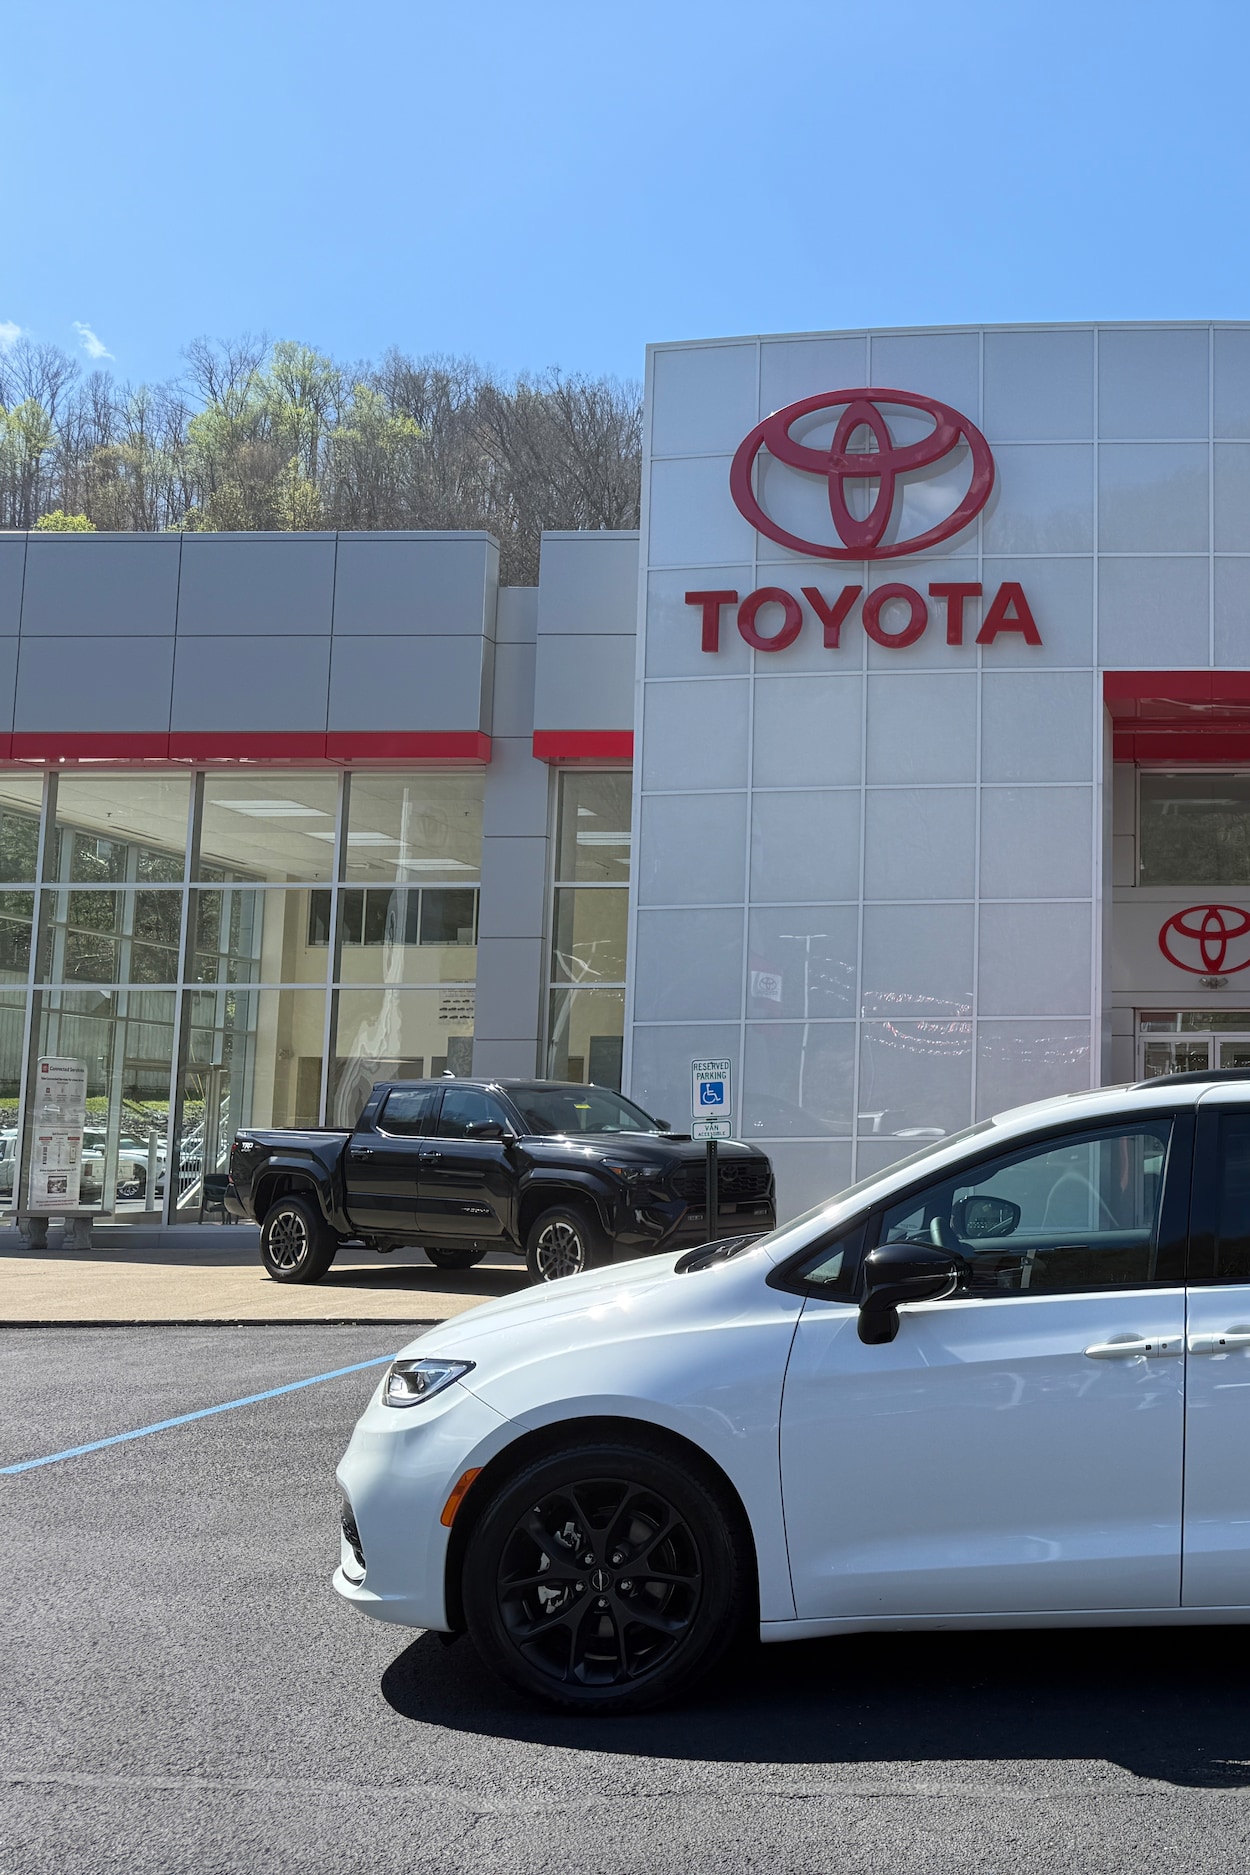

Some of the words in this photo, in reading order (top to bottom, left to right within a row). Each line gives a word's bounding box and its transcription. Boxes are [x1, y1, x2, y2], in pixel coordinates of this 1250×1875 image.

[685, 582, 1043, 653] TOYOTA
[693, 1061, 729, 1071] RESERVED
[696, 1071, 727, 1080] PARKING
